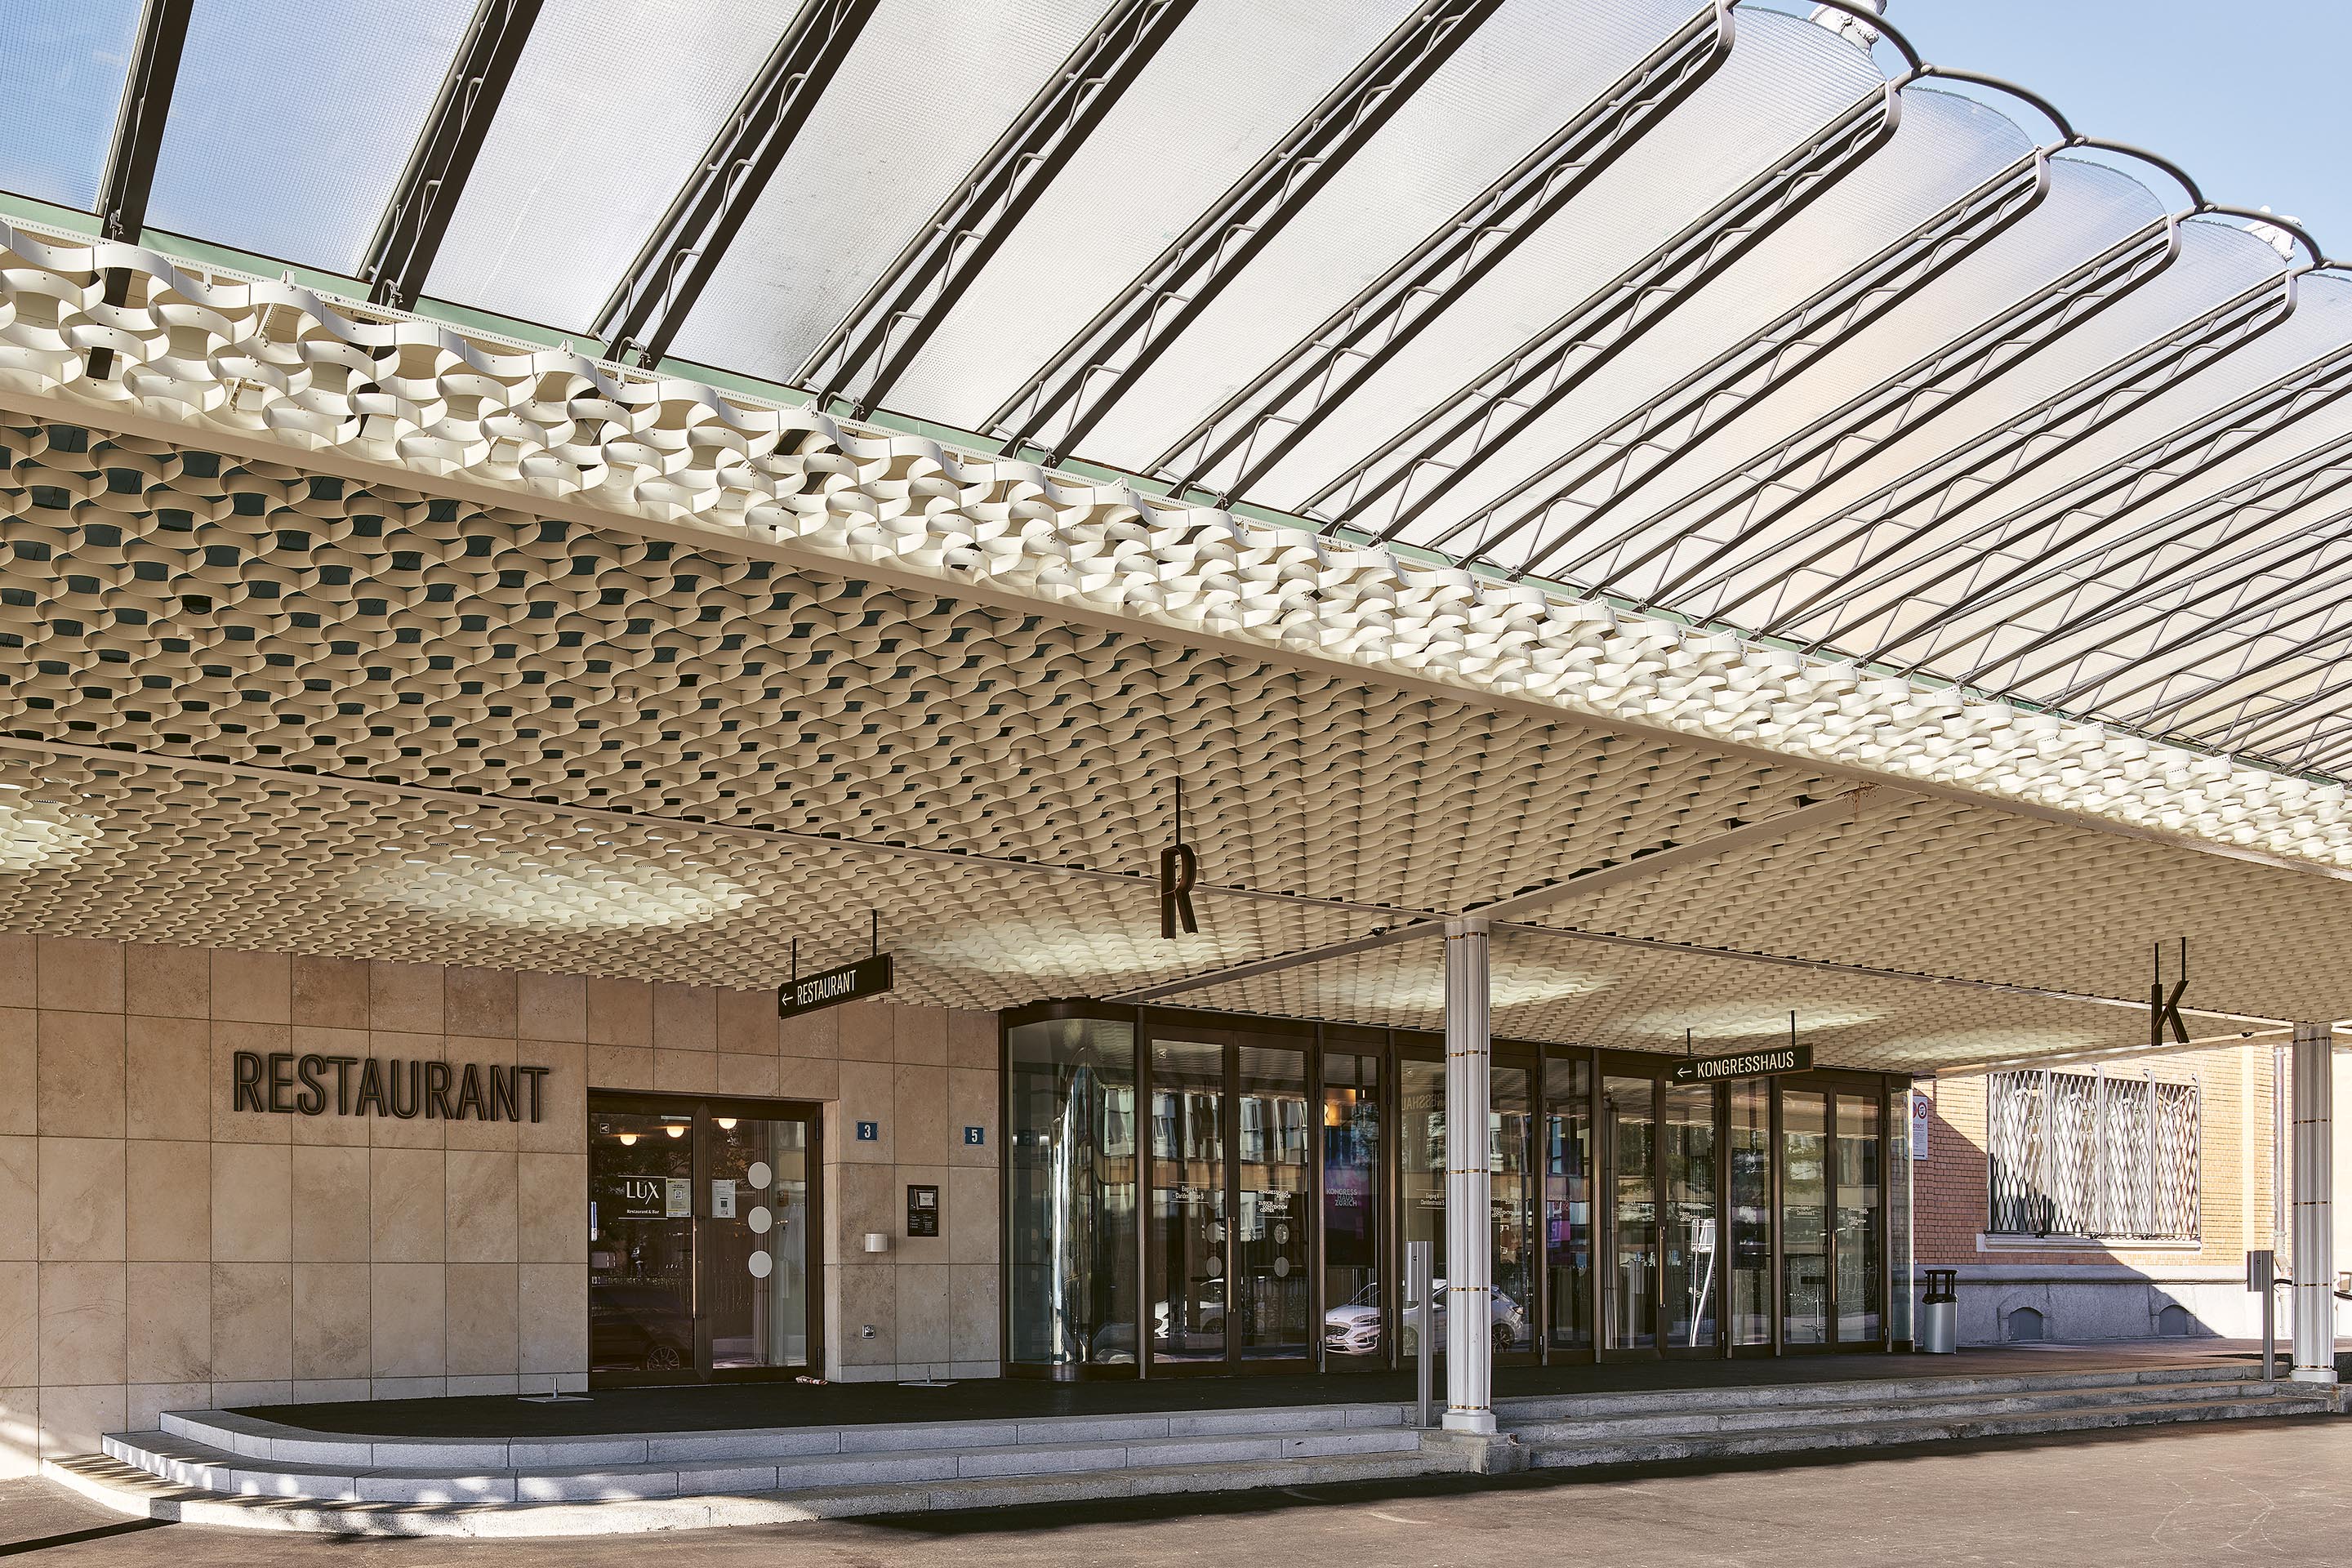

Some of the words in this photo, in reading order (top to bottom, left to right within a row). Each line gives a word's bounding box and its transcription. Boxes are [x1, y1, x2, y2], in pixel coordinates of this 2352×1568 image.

[1160, 844, 1199, 939] R
[797, 969, 857, 1006] RESTAURANT
[2151, 980, 2189, 1046] K
[1697, 1051, 1794, 1078] KONGRESSHAUS
[234, 1051, 550, 1124] RESTAURANT
[864, 1125, 871, 1138] 3
[971, 1129, 978, 1143] 5
[626, 1181, 660, 1205] LUX
